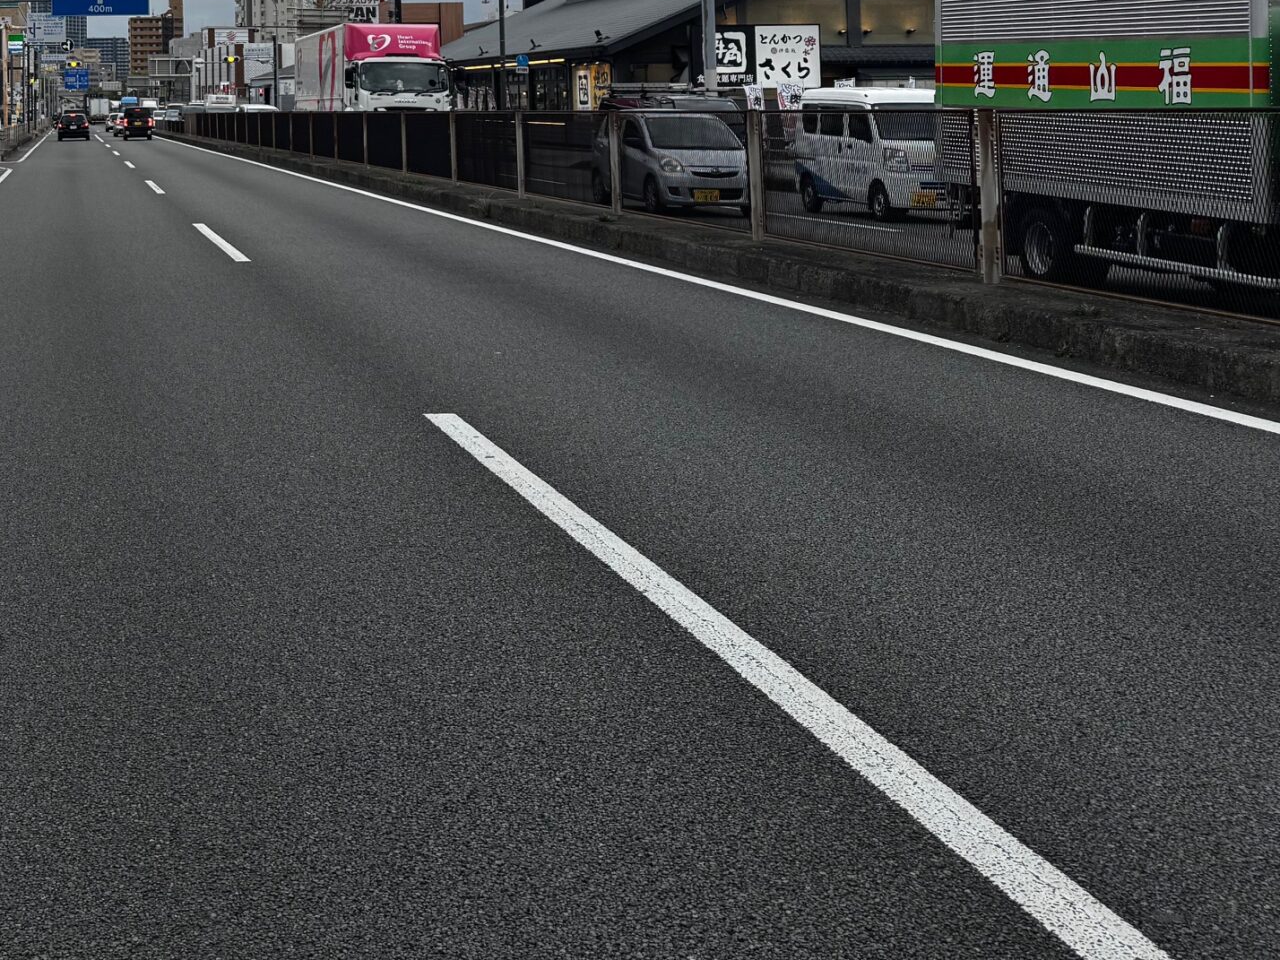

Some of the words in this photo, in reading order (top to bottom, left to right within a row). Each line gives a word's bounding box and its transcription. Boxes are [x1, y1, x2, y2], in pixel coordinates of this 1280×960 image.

[88, 4, 113, 13] 400m
[759, 33, 803, 45] とんかつ
[758, 58, 811, 80] さくら
